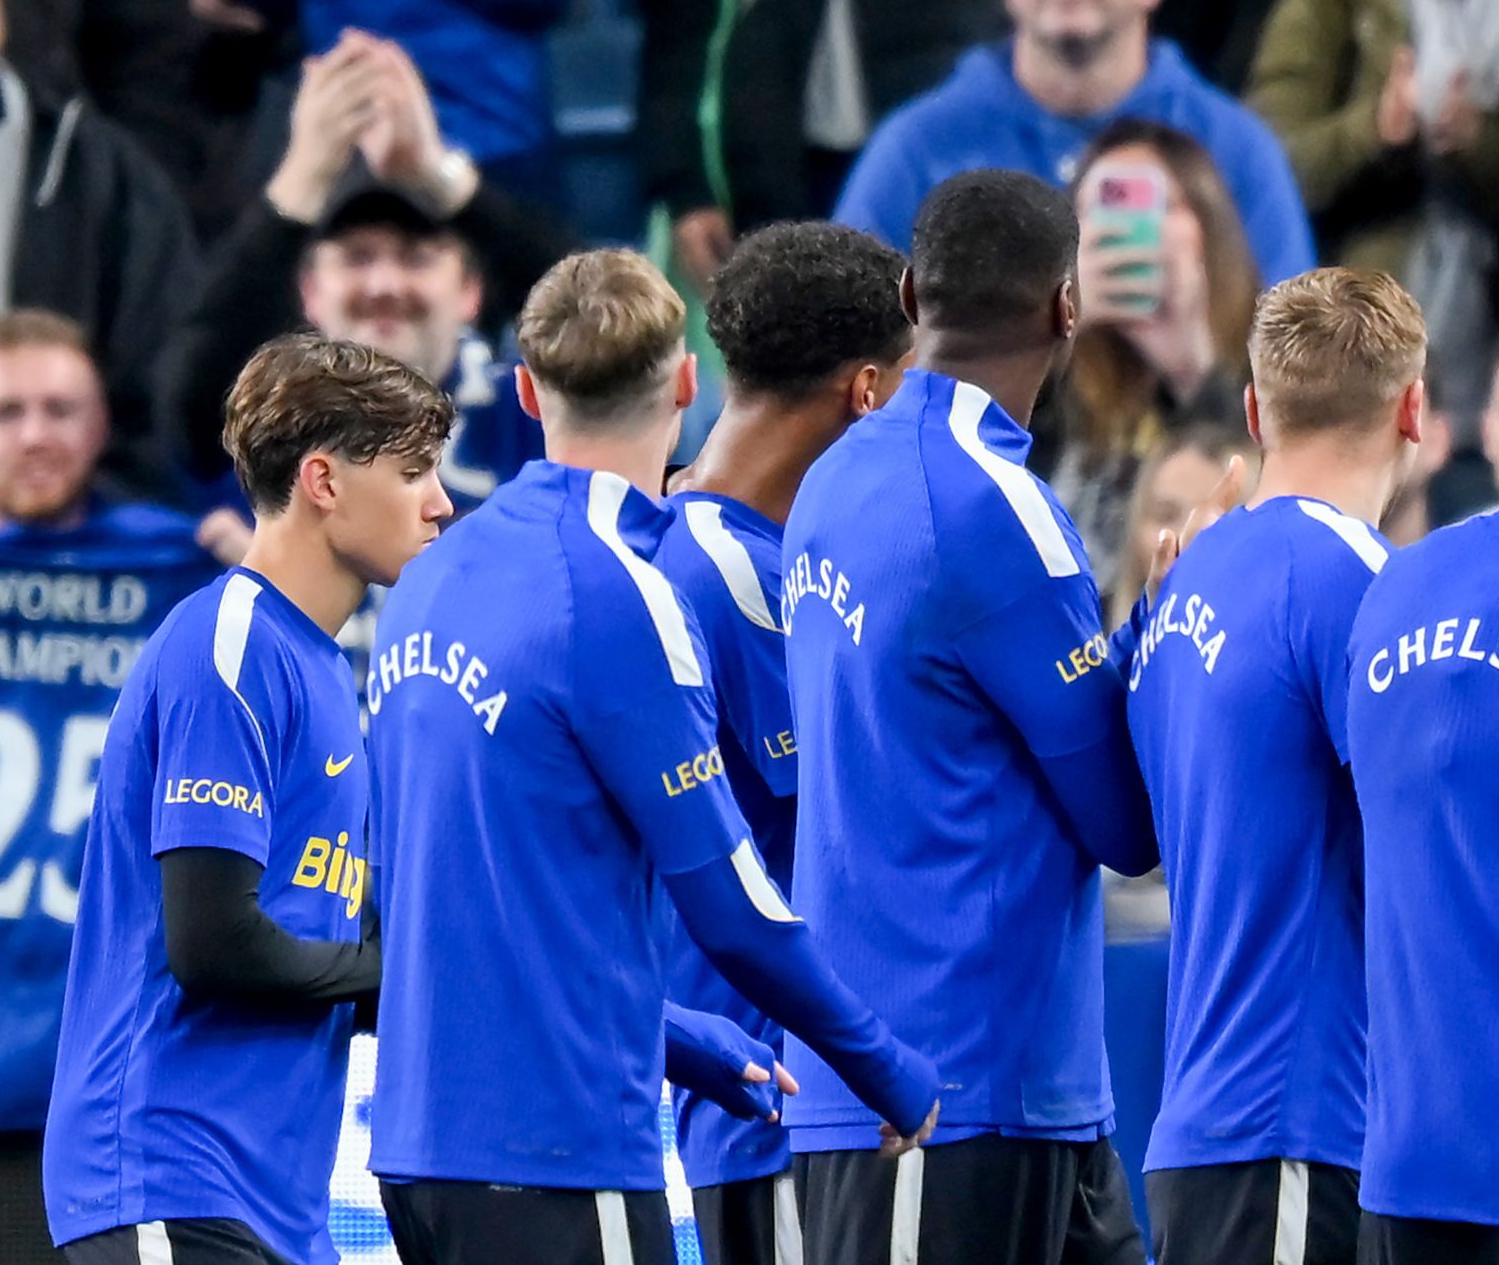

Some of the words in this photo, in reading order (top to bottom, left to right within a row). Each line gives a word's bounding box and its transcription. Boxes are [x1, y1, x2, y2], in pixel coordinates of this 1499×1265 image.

[781, 552, 865, 646] CHELSEA
[1056, 634, 1109, 684] LEGO
[1129, 593, 1227, 693] CHELSEA
[367, 631, 508, 736] CHELSEA
[764, 730, 798, 759] LE
[661, 745, 724, 797] LEGO
[165, 779, 263, 818] LEGORA
